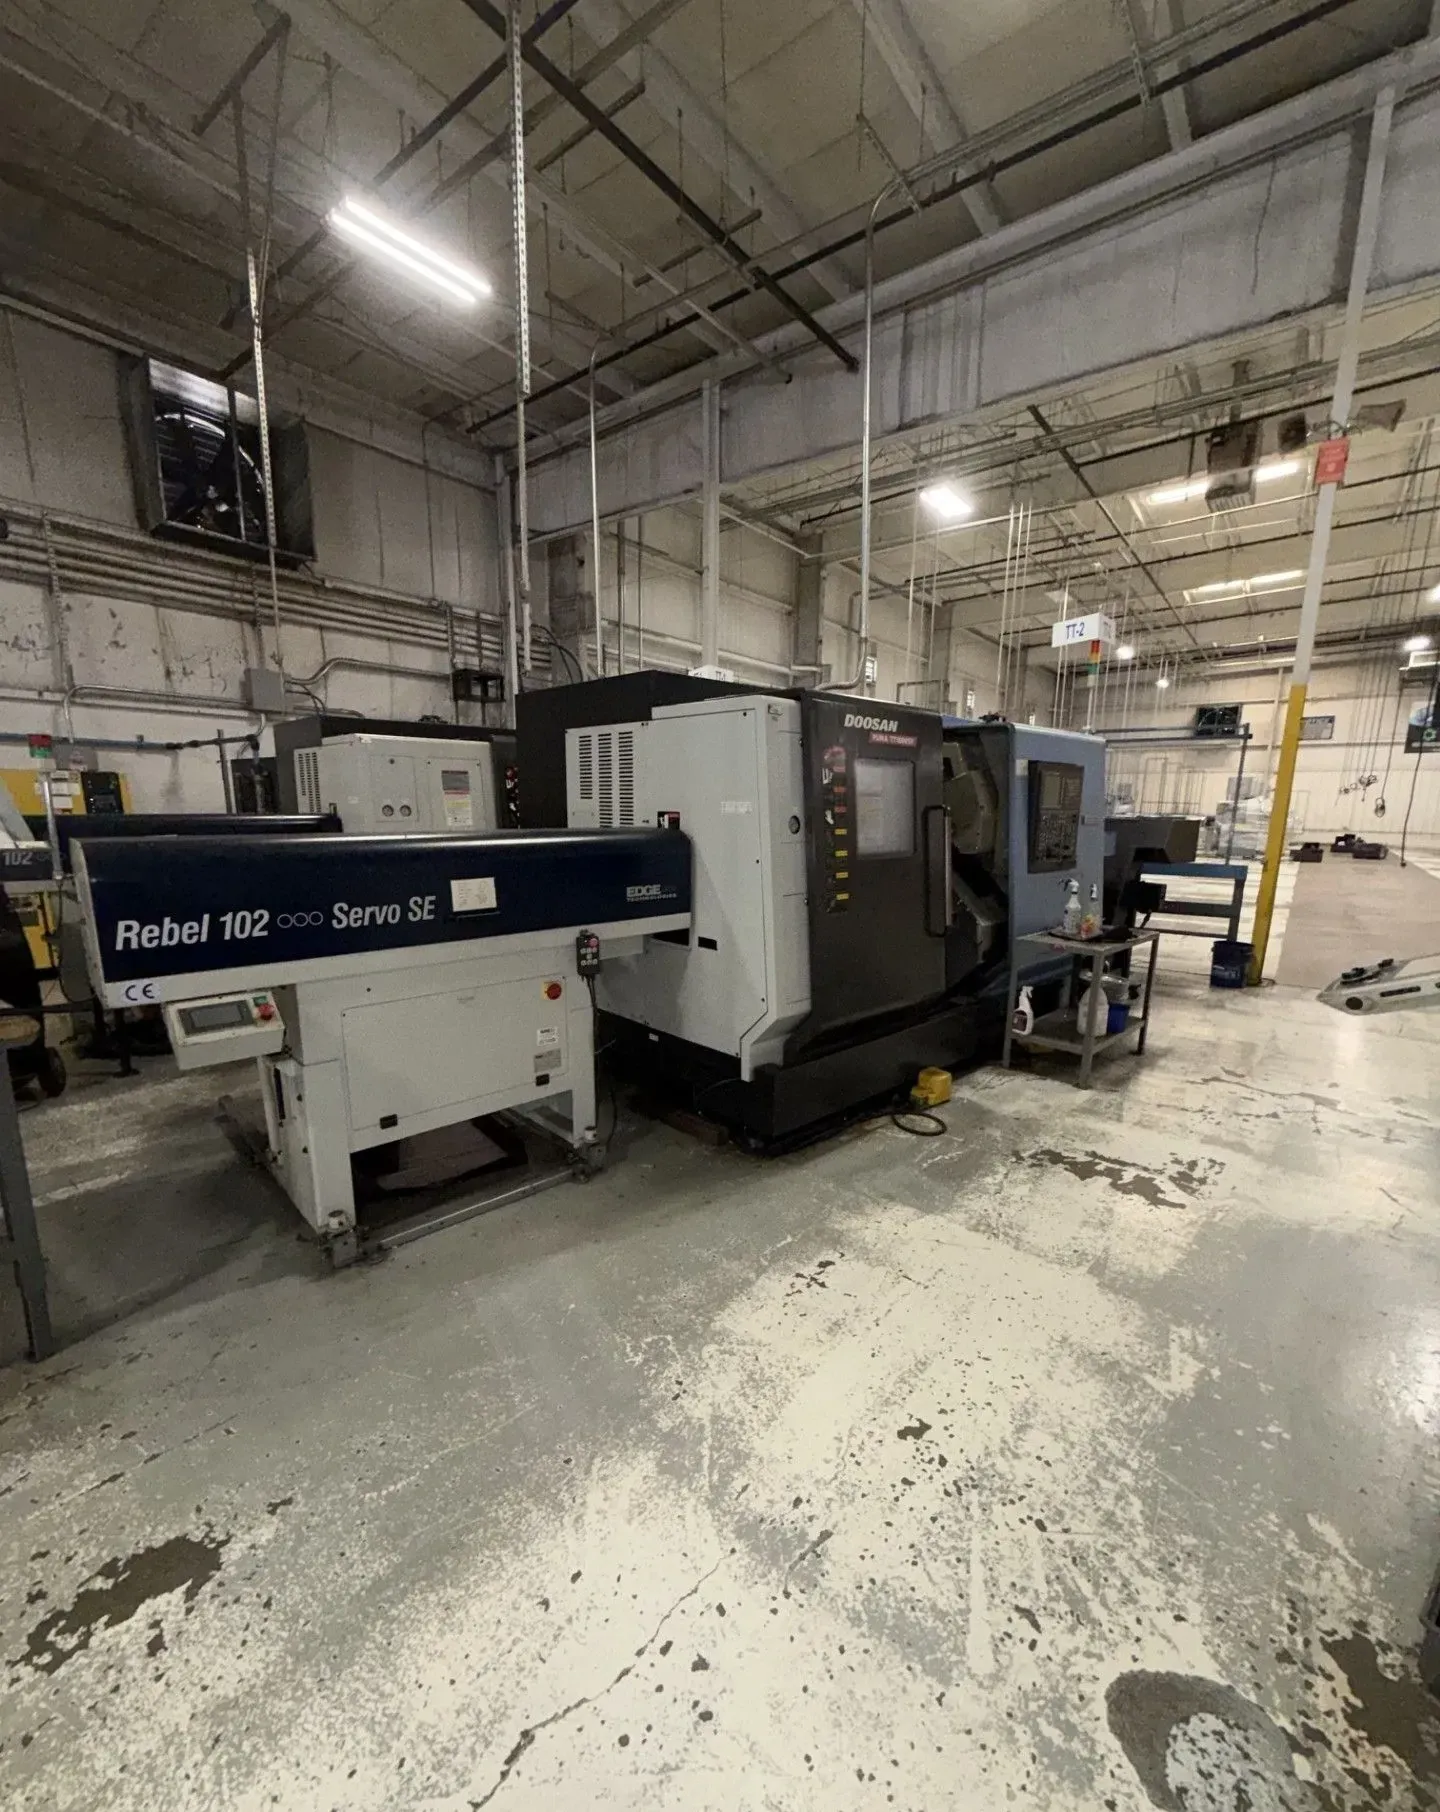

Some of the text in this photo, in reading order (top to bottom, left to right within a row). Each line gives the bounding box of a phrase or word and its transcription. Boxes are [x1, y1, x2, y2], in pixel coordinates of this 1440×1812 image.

[1066, 622, 1085, 640] TT-2
[844, 713, 899, 733] DOOSAN
[3, 852, 33, 866] 102
[626, 884, 662, 898] EDGE
[115, 896, 437, 951] Rebel 102 Servo SE
